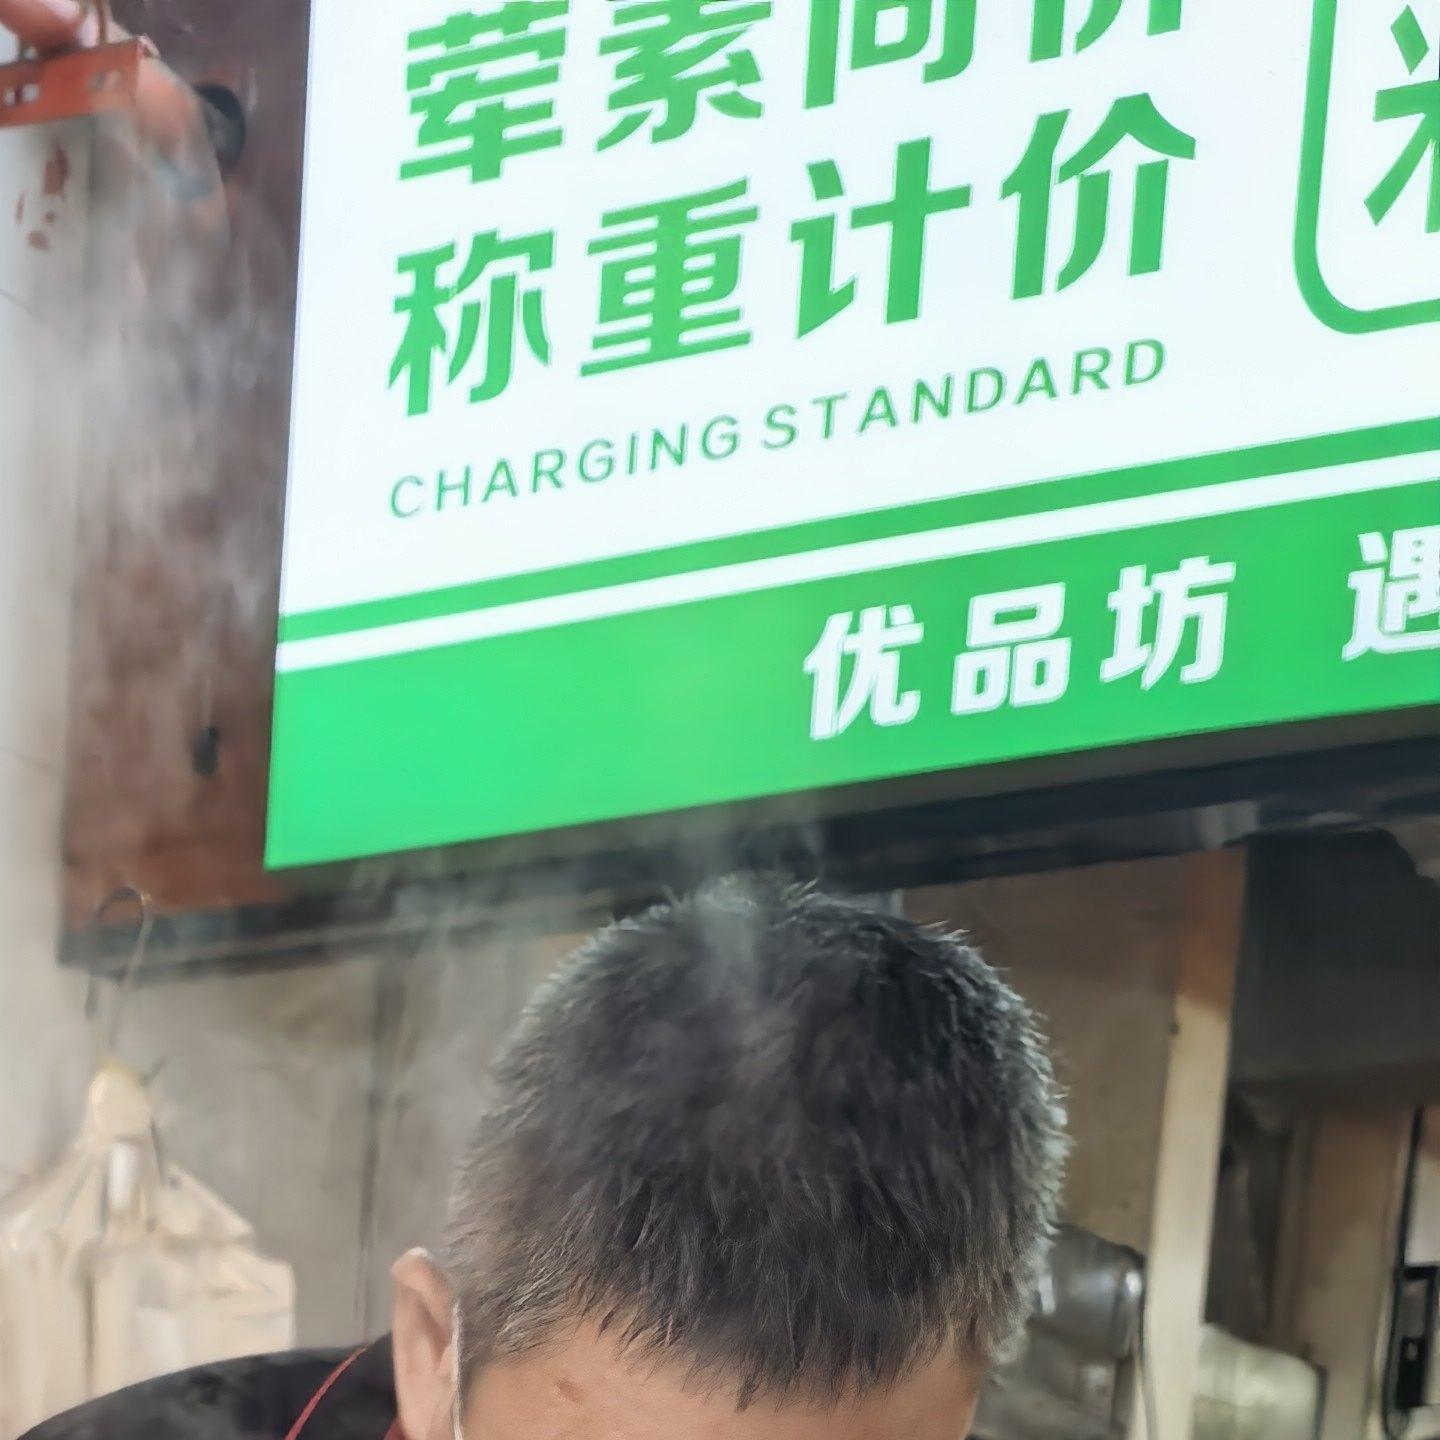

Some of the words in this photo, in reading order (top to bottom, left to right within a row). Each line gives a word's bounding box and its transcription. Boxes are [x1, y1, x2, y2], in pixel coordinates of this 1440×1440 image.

[390, 92, 1197, 417] 称重计价
[389, 414, 741, 519] CHARGING
[760, 337, 1165, 450] STANDARD
[803, 556, 1236, 740] 优品坊
